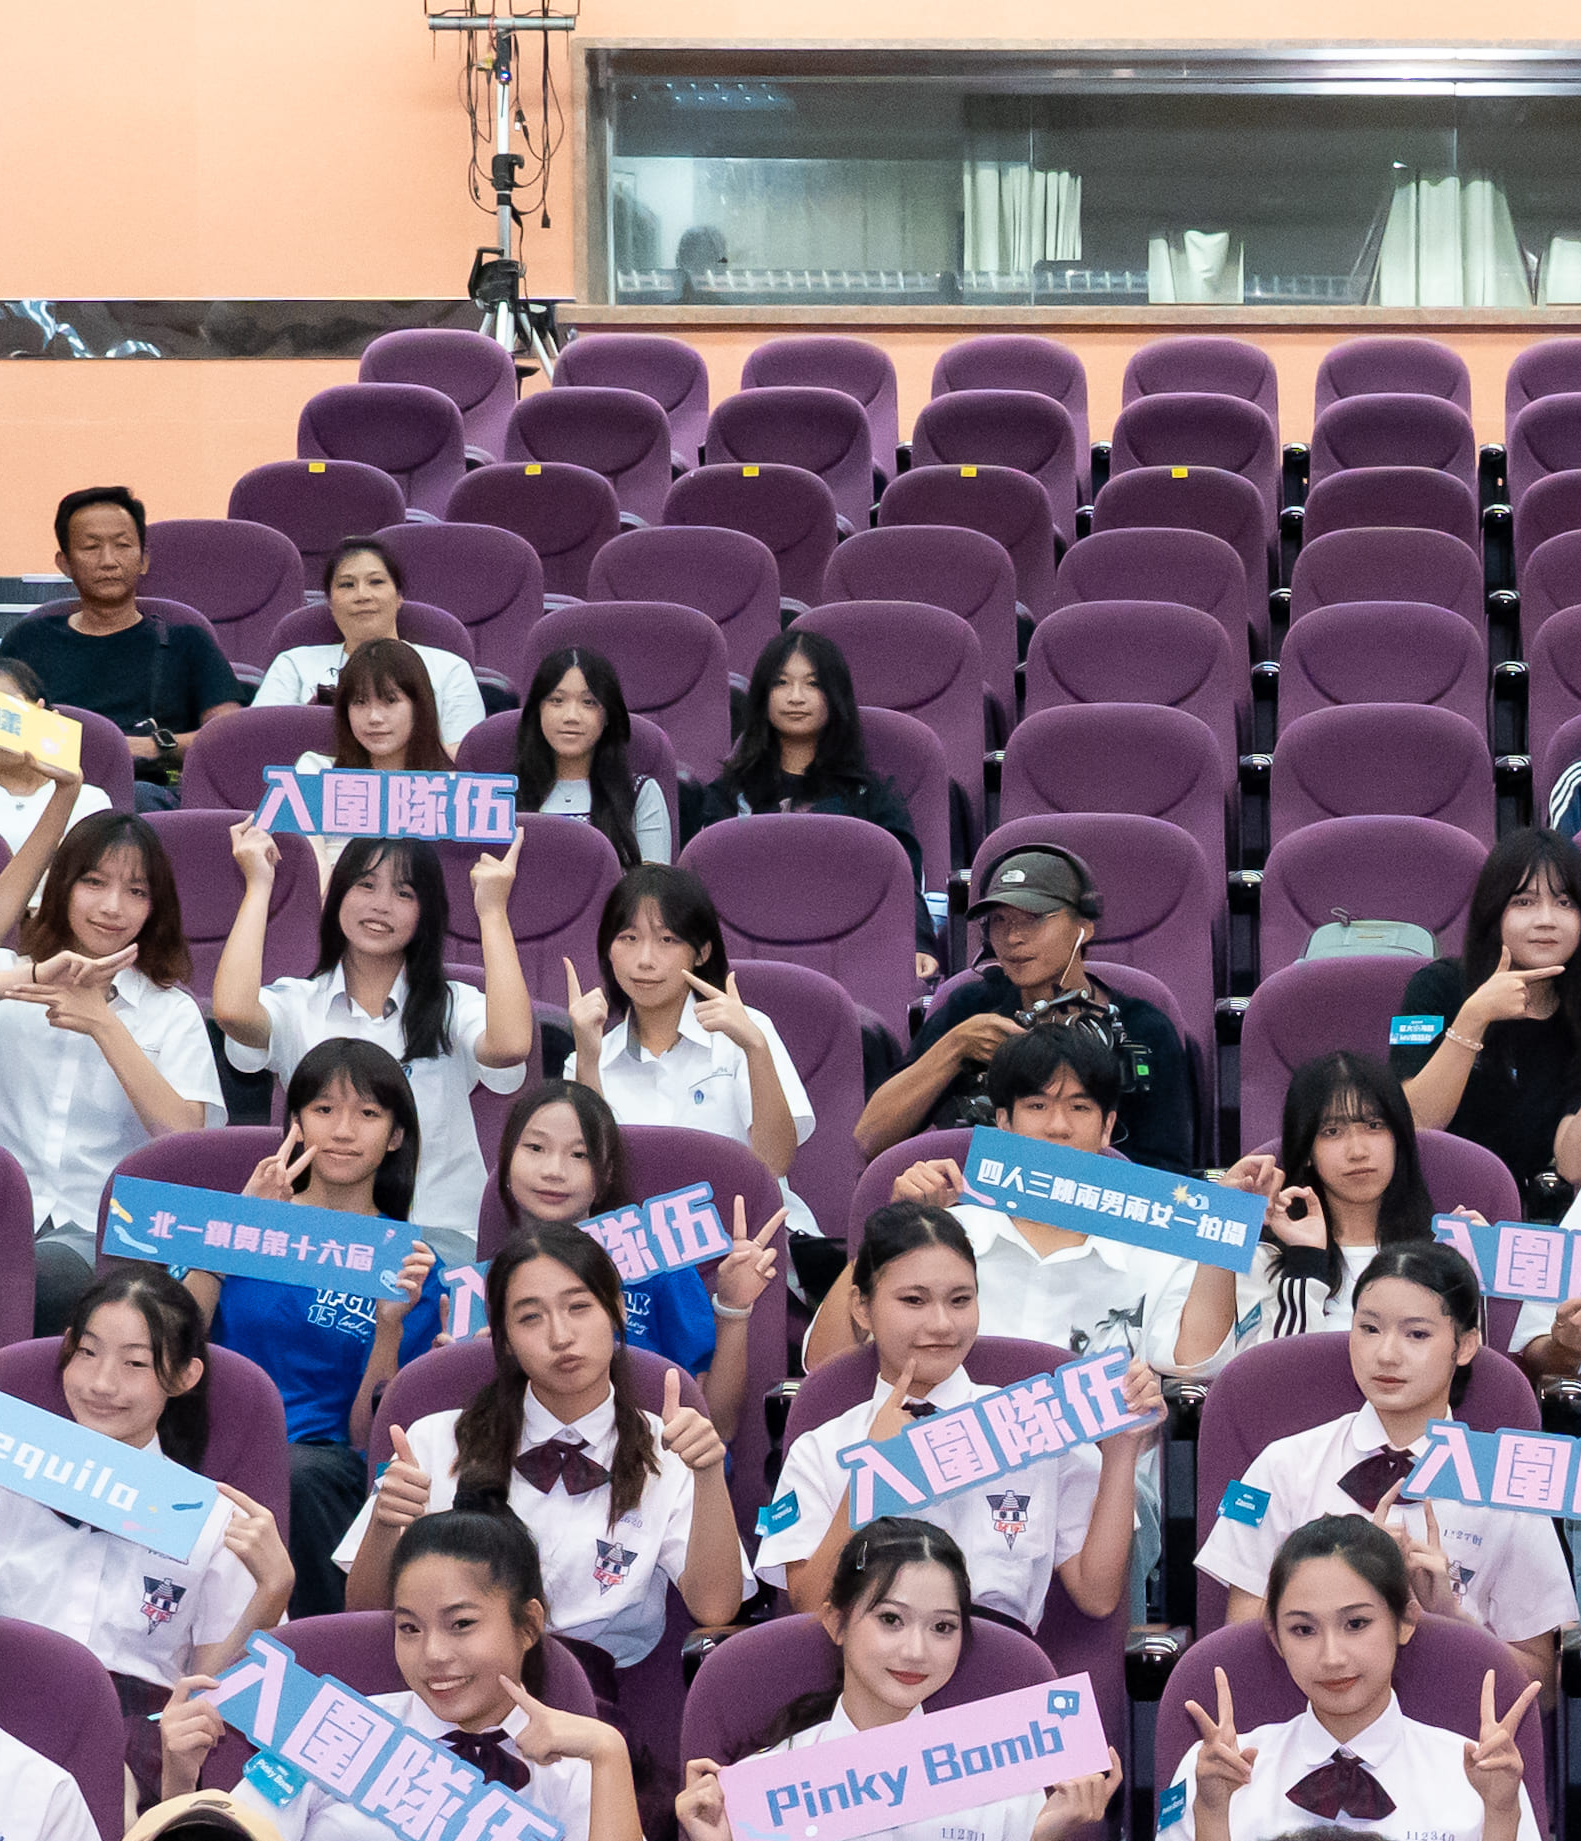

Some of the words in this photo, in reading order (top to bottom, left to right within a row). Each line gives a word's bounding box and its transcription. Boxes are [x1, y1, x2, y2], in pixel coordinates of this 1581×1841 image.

[257, 769, 518, 839] 入圍隊伍
[846, 1352, 1153, 1523] 入圍隊伍
[766, 1762, 908, 1828] Pinky
[924, 1720, 1065, 1787] Bomb
